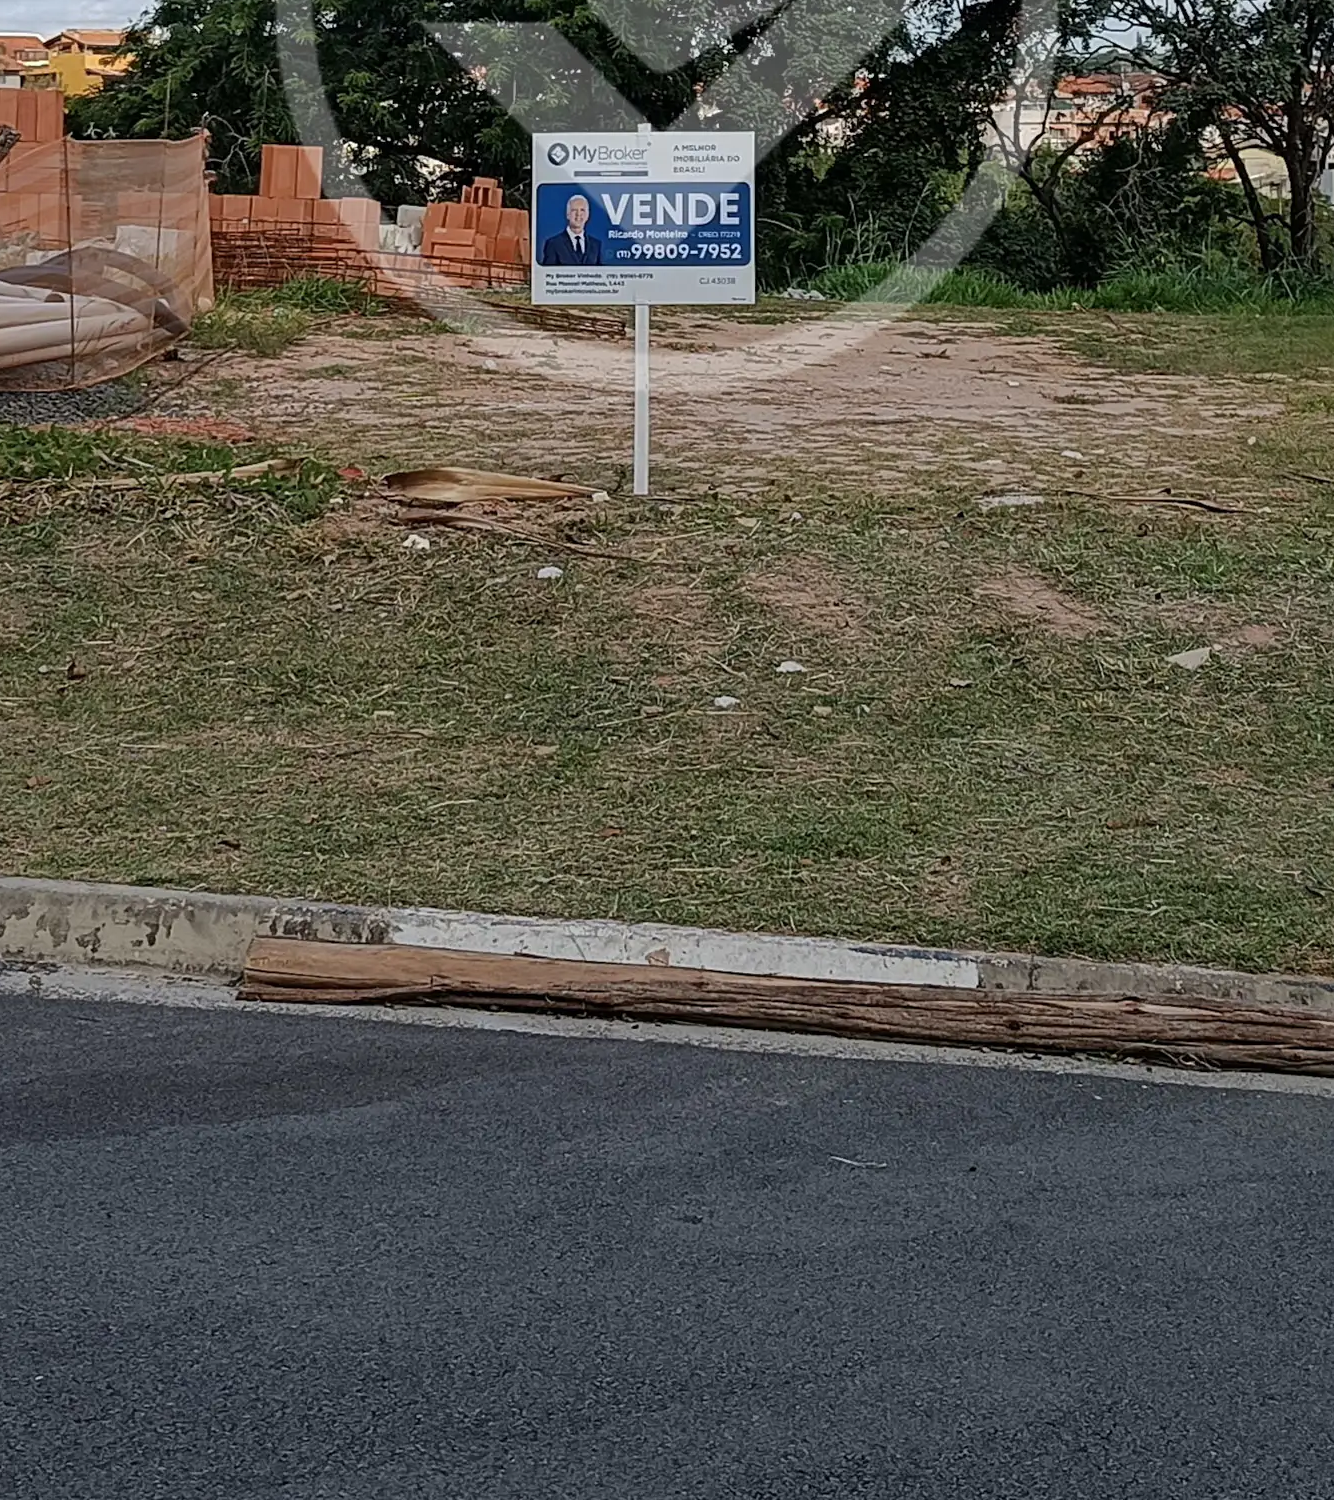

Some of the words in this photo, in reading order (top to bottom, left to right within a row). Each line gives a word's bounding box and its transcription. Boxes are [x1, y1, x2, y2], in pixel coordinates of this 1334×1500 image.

[572, 145, 648, 163] MyBroker
[673, 154, 725, 162] IMOBILIÁRIA
[601, 192, 740, 225] VENDE
[608, 230, 645, 239] Ricardo
[646, 230, 689, 239] Monteiro
